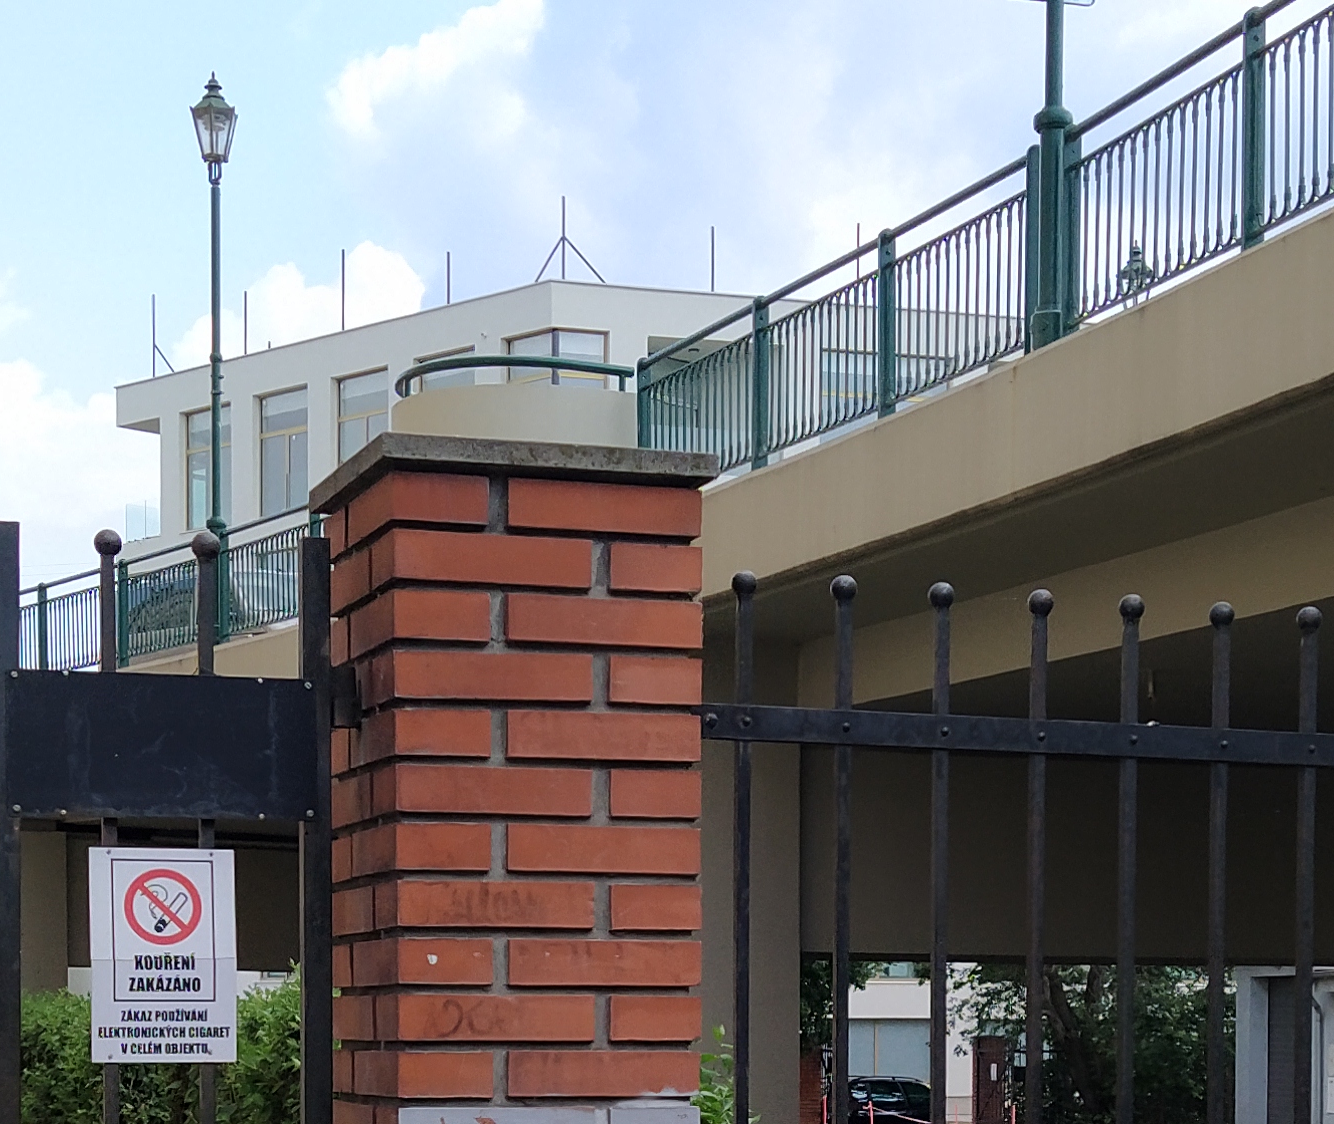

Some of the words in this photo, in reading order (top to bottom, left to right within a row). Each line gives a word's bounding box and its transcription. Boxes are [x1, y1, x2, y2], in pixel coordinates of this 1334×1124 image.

[134, 952, 196, 970] KOUŘENÍ
[128, 974, 201, 992] ZAKÁZÁNO
[121, 1008, 153, 1022] ZÁKAZ
[155, 1008, 208, 1022] POUŽÍVÁNÍ
[98, 1025, 186, 1039] ELEKTRONICKÝCH
[188, 1026, 230, 1038] CIGARET
[121, 1043, 128, 1054] V
[130, 1041, 162, 1054] CELÉM
